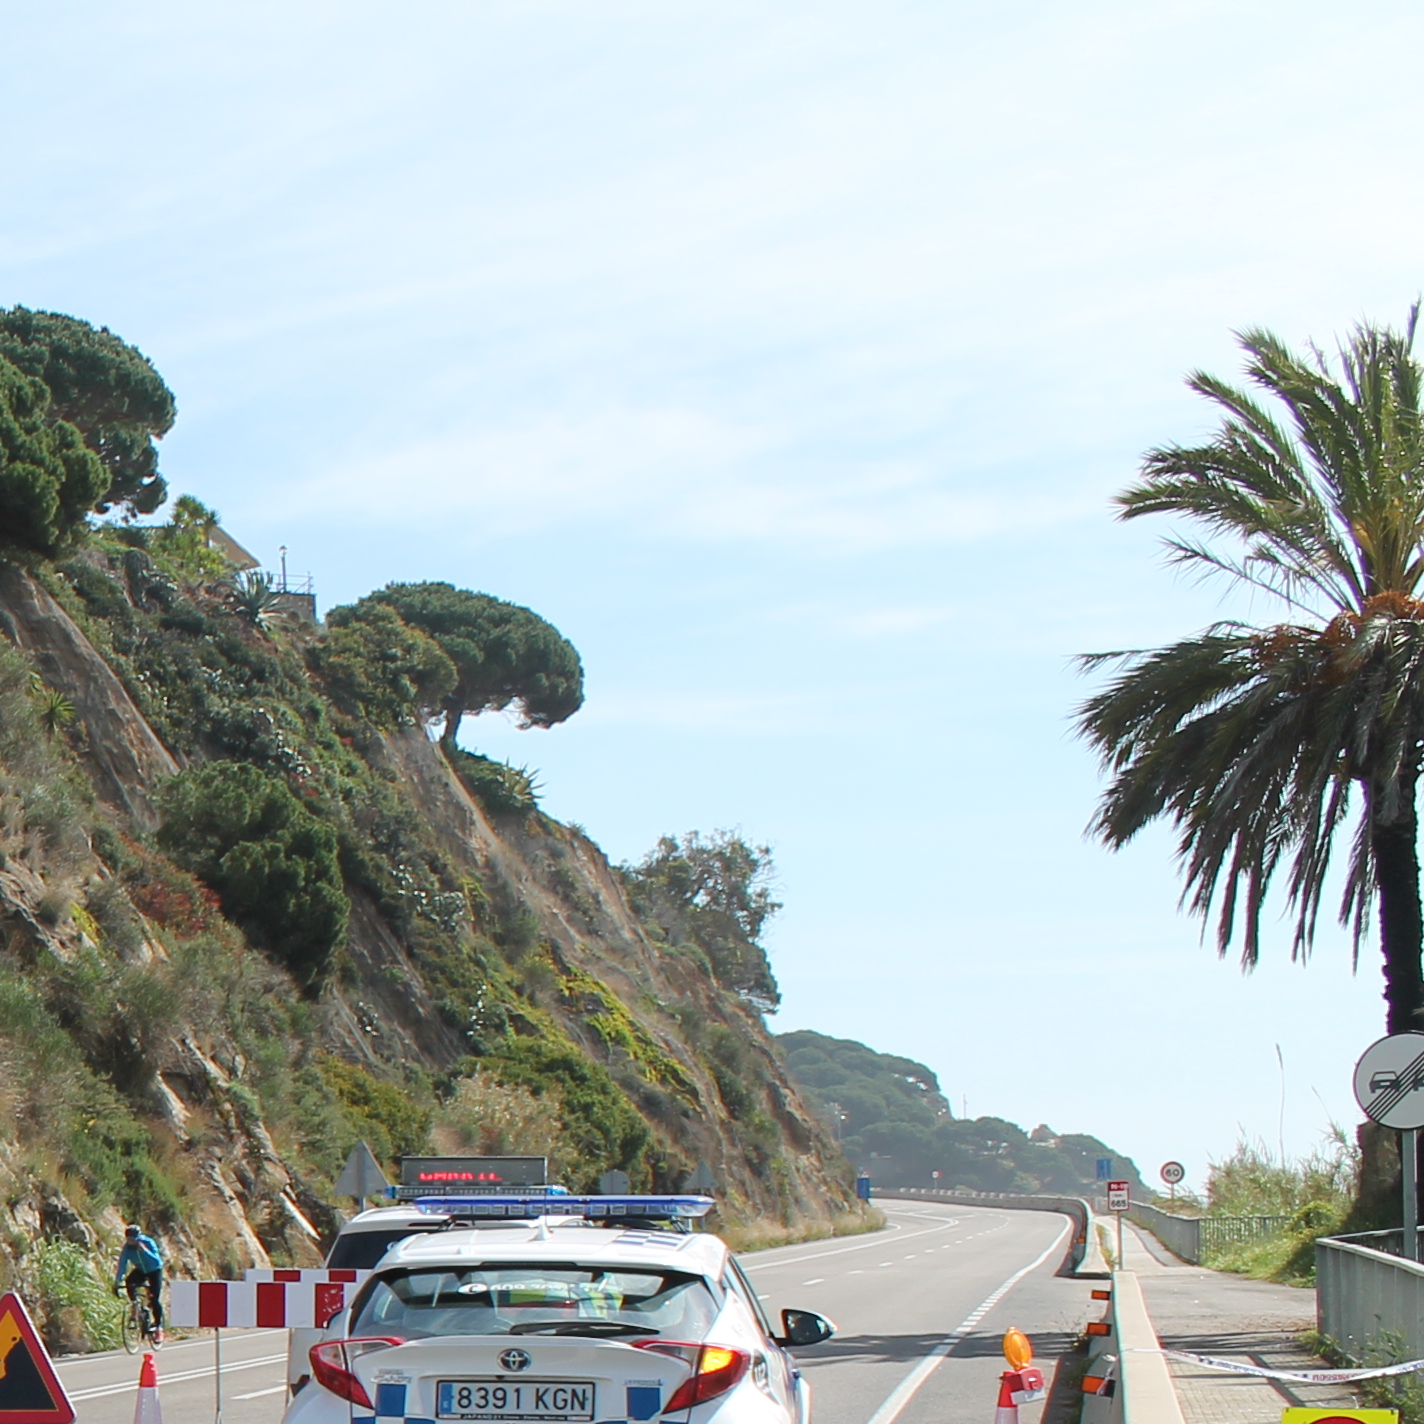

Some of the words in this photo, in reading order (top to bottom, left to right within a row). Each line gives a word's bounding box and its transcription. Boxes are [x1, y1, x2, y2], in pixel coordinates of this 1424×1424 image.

[1165, 1168, 1180, 1177] 60
[457, 1387, 522, 1410] 8391
[535, 1387, 587, 1411] KGN
